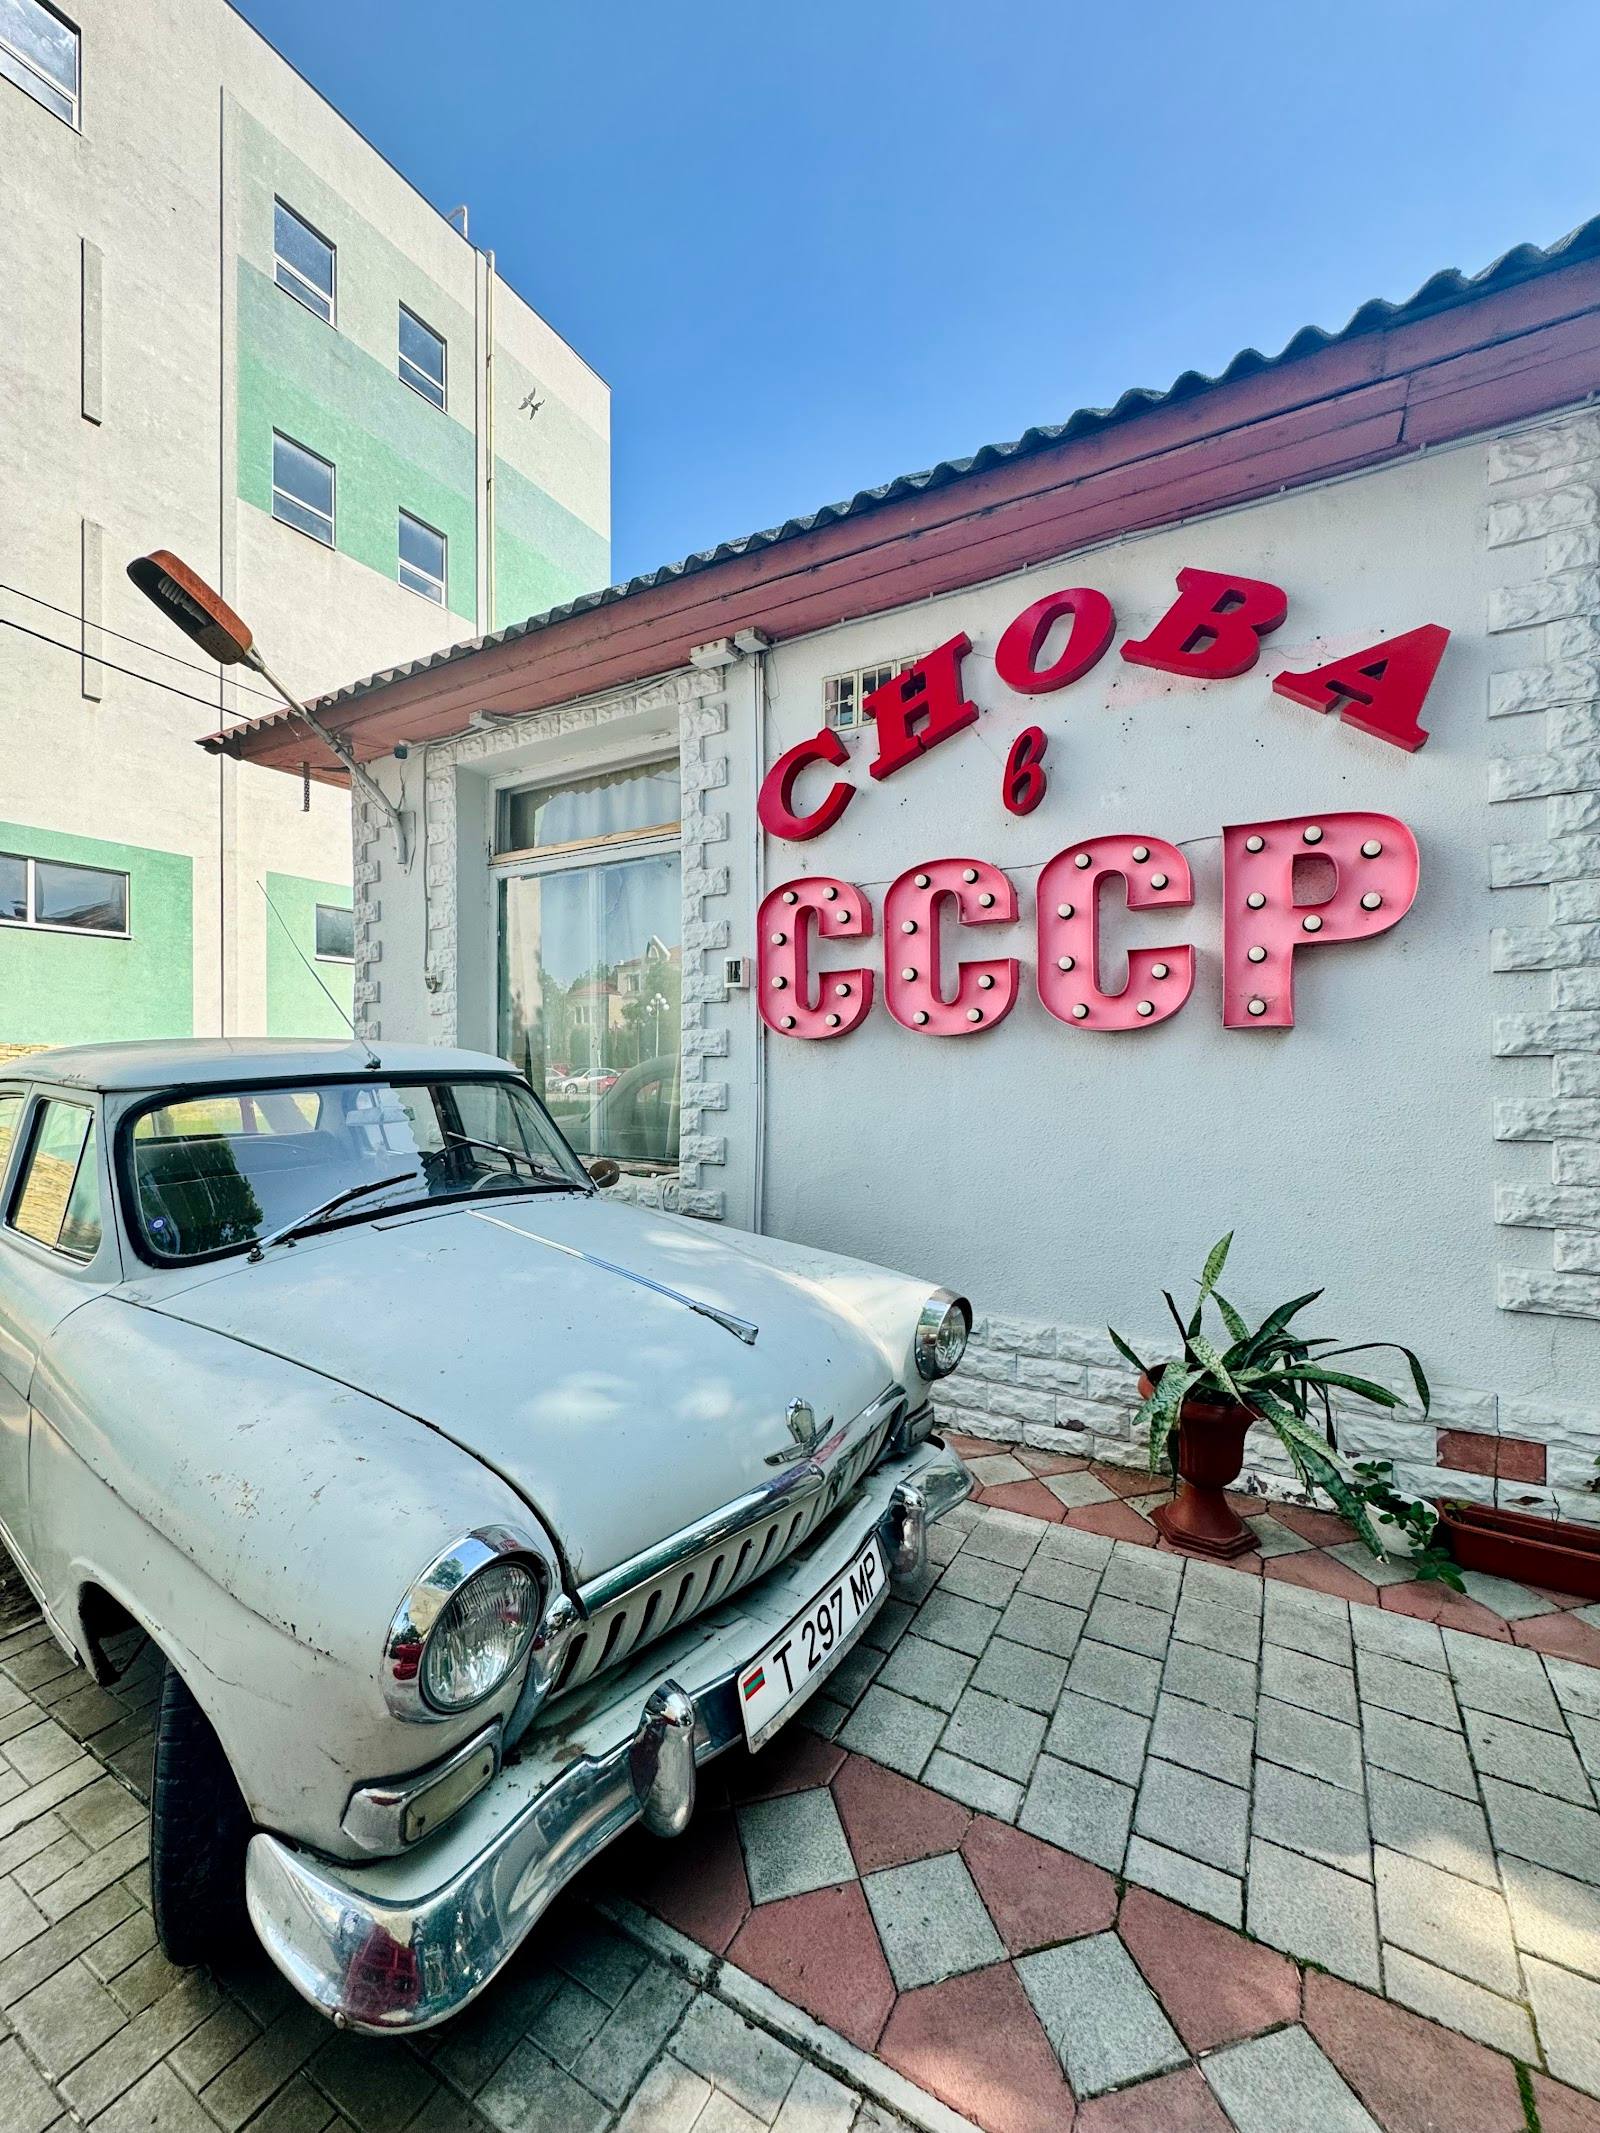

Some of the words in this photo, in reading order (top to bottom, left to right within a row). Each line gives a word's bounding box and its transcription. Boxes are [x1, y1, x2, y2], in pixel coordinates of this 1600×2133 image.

[758, 567, 1451, 842] СНОВА
[757, 811, 1421, 1040] СССР
[772, 1640, 793, 1694] T
[802, 1586, 843, 1671] 297
